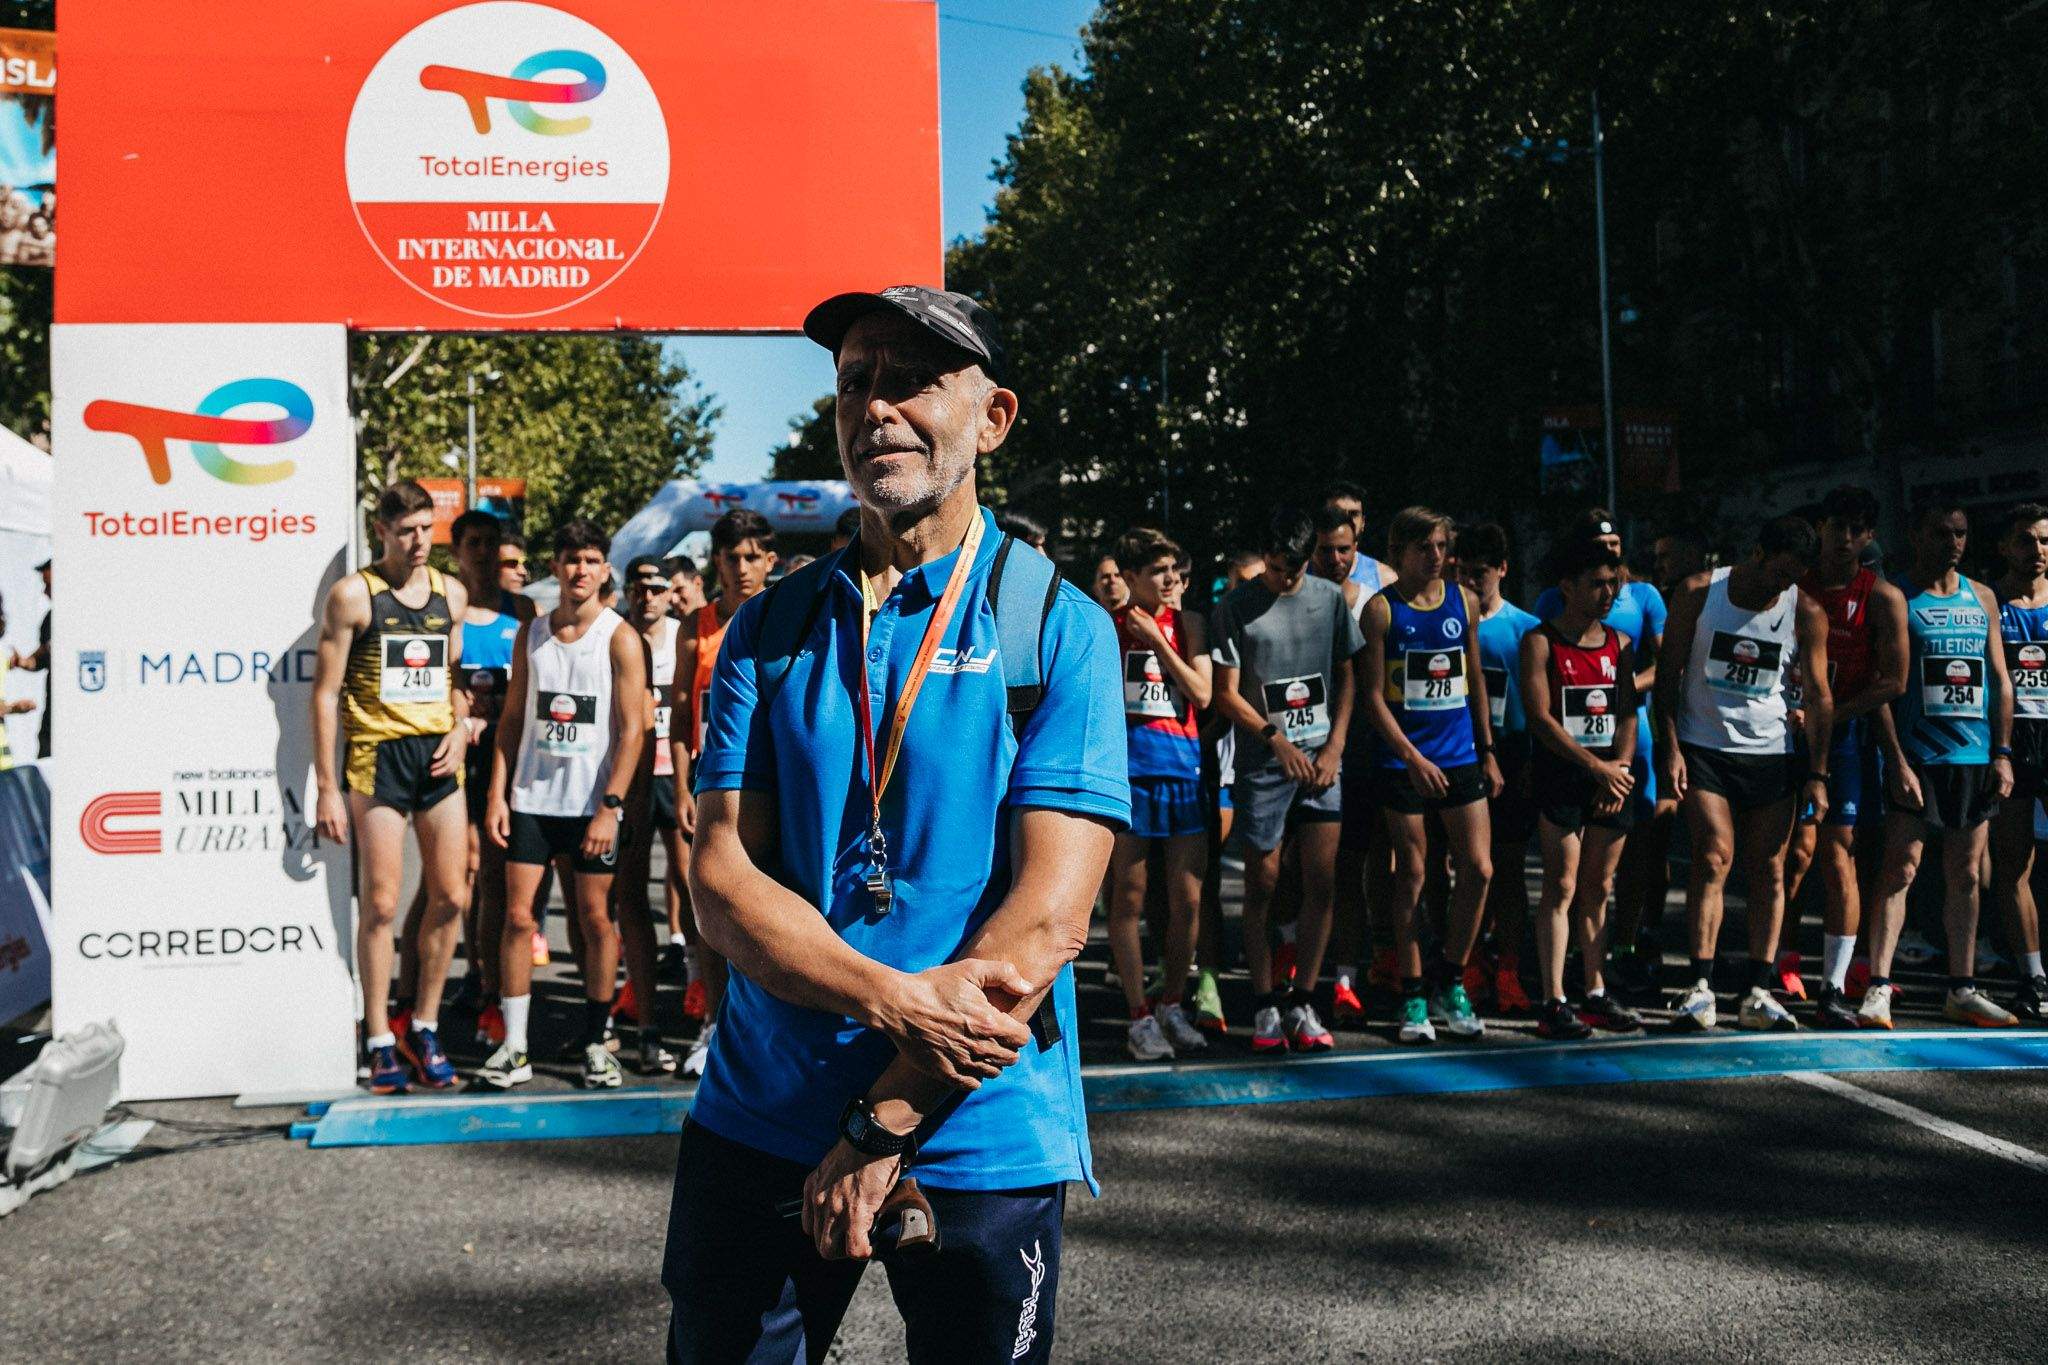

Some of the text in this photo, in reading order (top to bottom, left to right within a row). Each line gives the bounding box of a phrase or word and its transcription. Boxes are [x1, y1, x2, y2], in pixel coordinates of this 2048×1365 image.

[419, 155, 609, 182] TotalEnergies
[466, 210, 556, 232] MILLA
[432, 265, 590, 288] DE MADRID
[83, 509, 317, 541] TotalEnergies
[141, 652, 318, 683] MADRID
[403, 669, 432, 688] 240
[1724, 662, 1759, 685] 291
[2015, 669, 2048, 688] 259
[1425, 680, 1452, 698] 278
[1943, 685, 1974, 704] 254
[1286, 707, 1314, 729] 245
[1583, 716, 1609, 735] 281
[546, 723, 577, 742] 290
